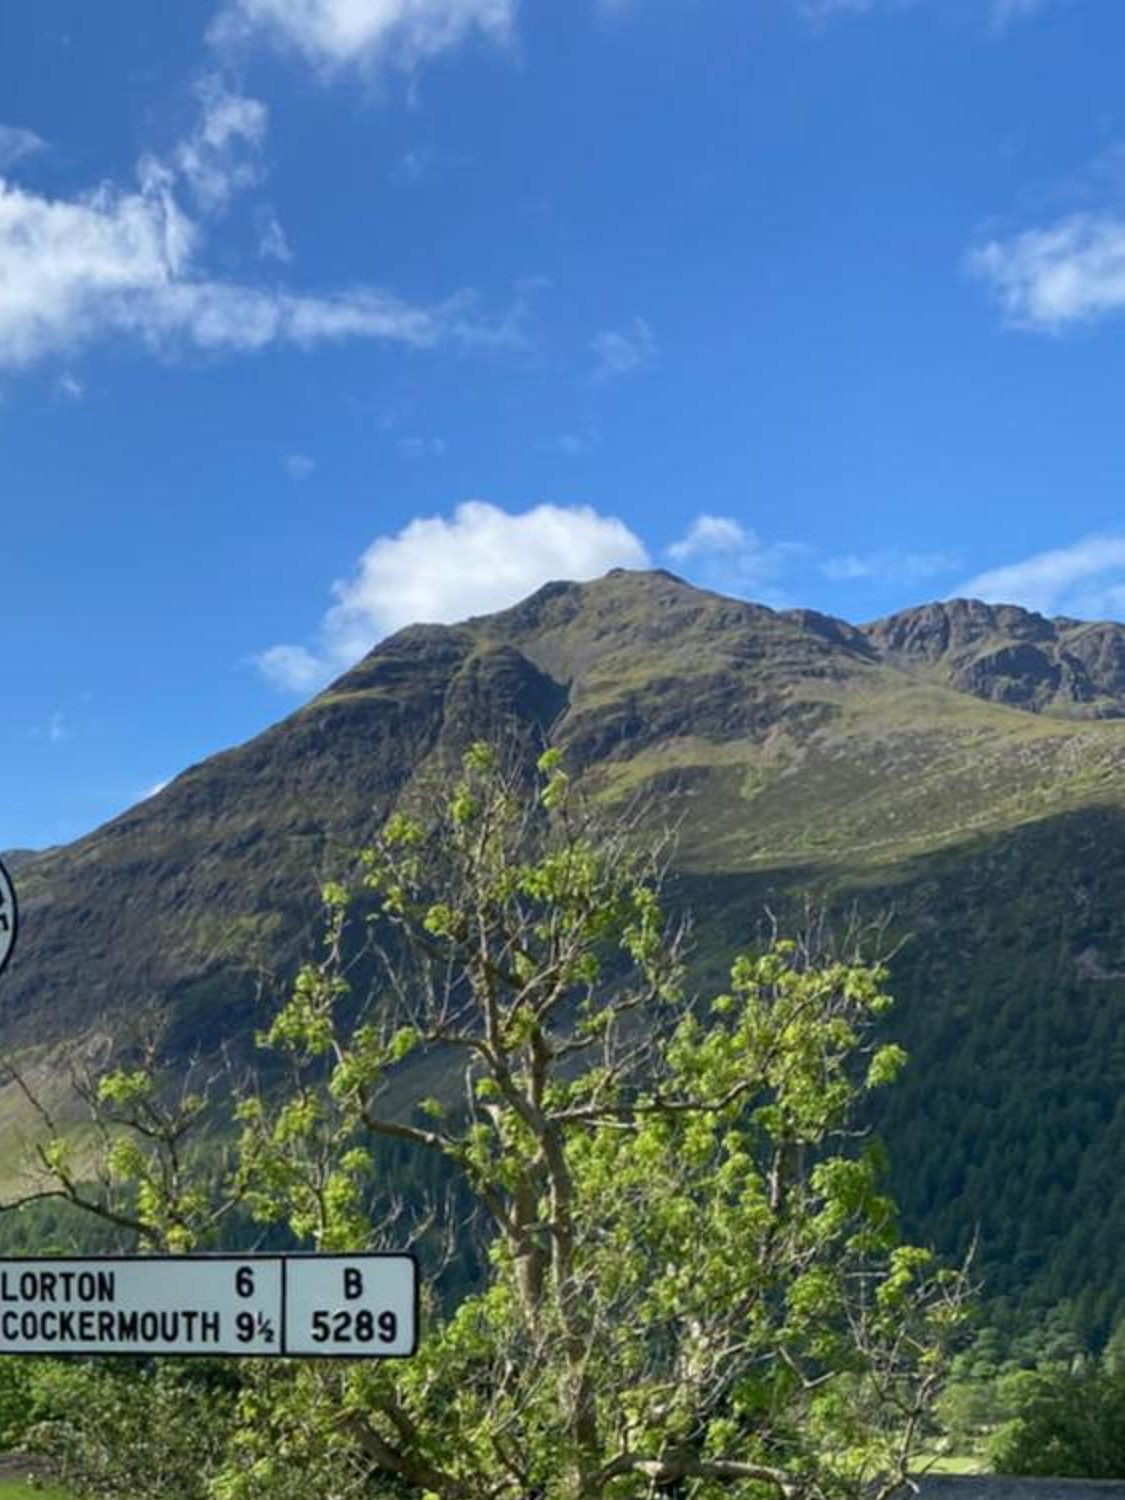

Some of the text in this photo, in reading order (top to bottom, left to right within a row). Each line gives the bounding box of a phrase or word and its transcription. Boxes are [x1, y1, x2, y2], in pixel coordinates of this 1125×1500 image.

[0, 1266, 255, 1303] LORTON 6
[343, 1267, 364, 1301] B
[1, 1310, 221, 1344] COCKERMOUTH
[311, 1309, 398, 1344] 5289
